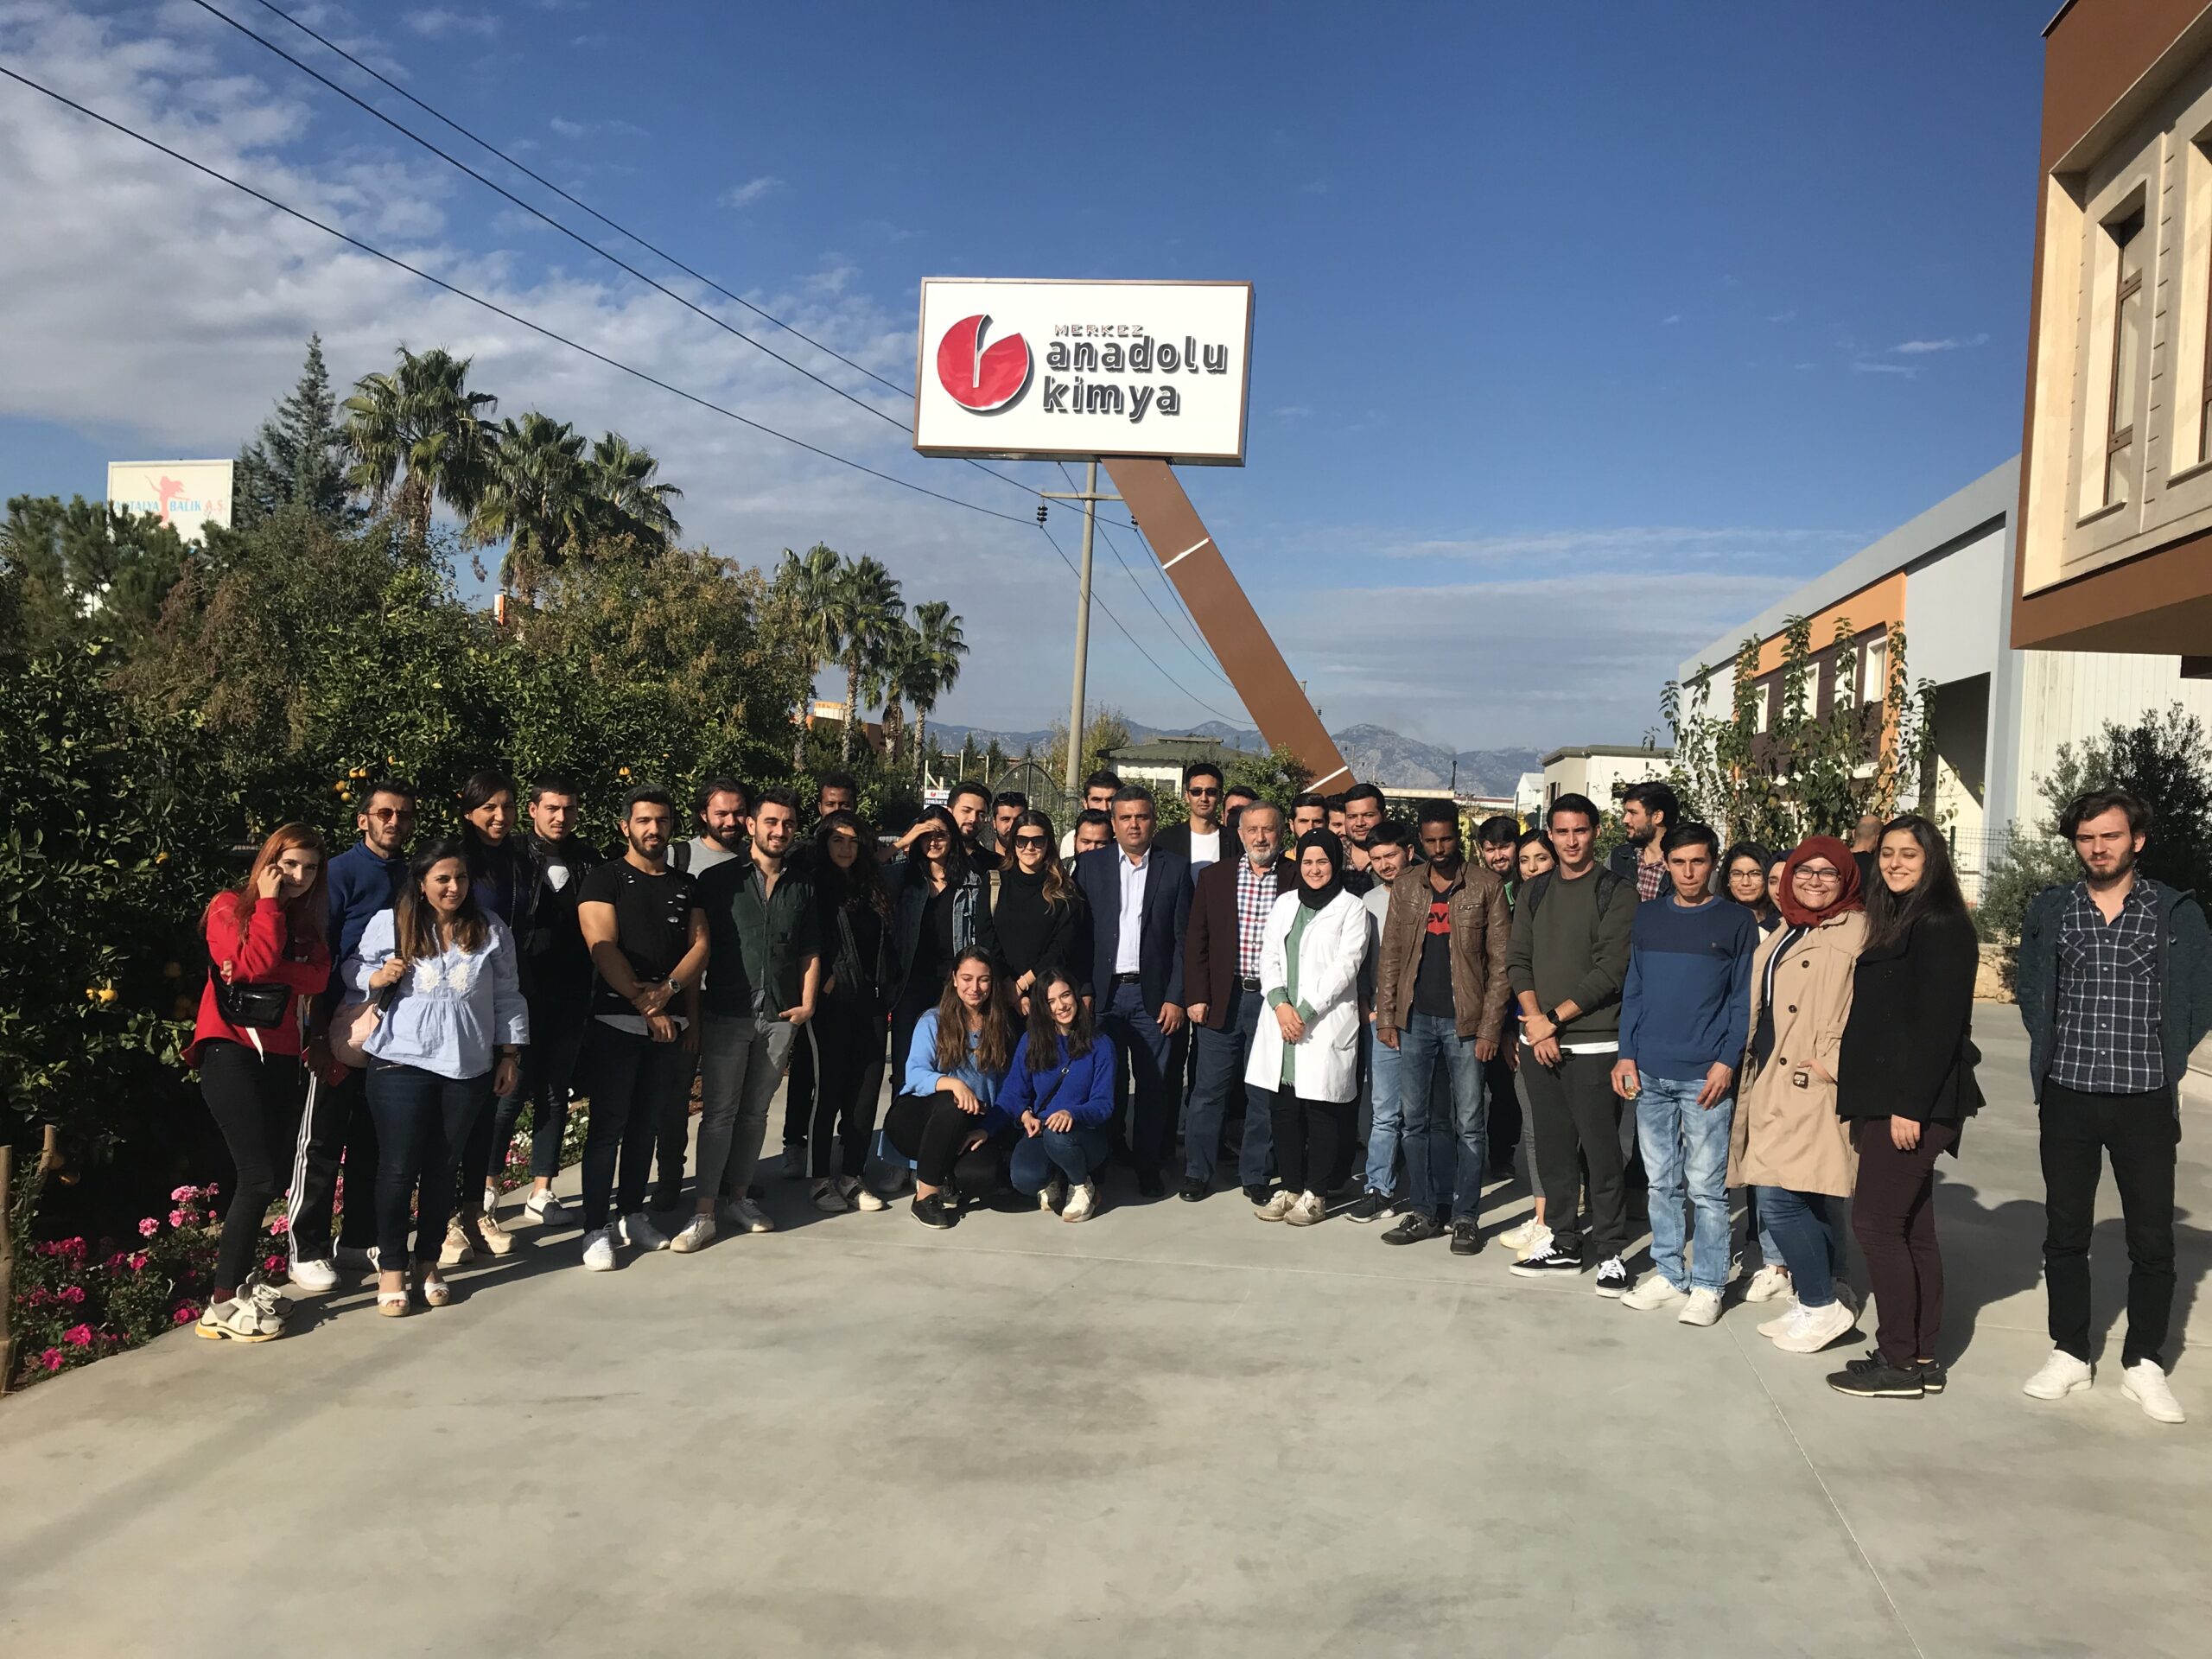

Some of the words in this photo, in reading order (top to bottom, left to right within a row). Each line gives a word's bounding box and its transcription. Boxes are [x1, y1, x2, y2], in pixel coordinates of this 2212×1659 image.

[1054, 324, 1144, 337] MERKEZ
[1046, 335, 1229, 374] anadolu
[1042, 375, 1181, 423] kimya
[114, 500, 160, 512] ATALYA
